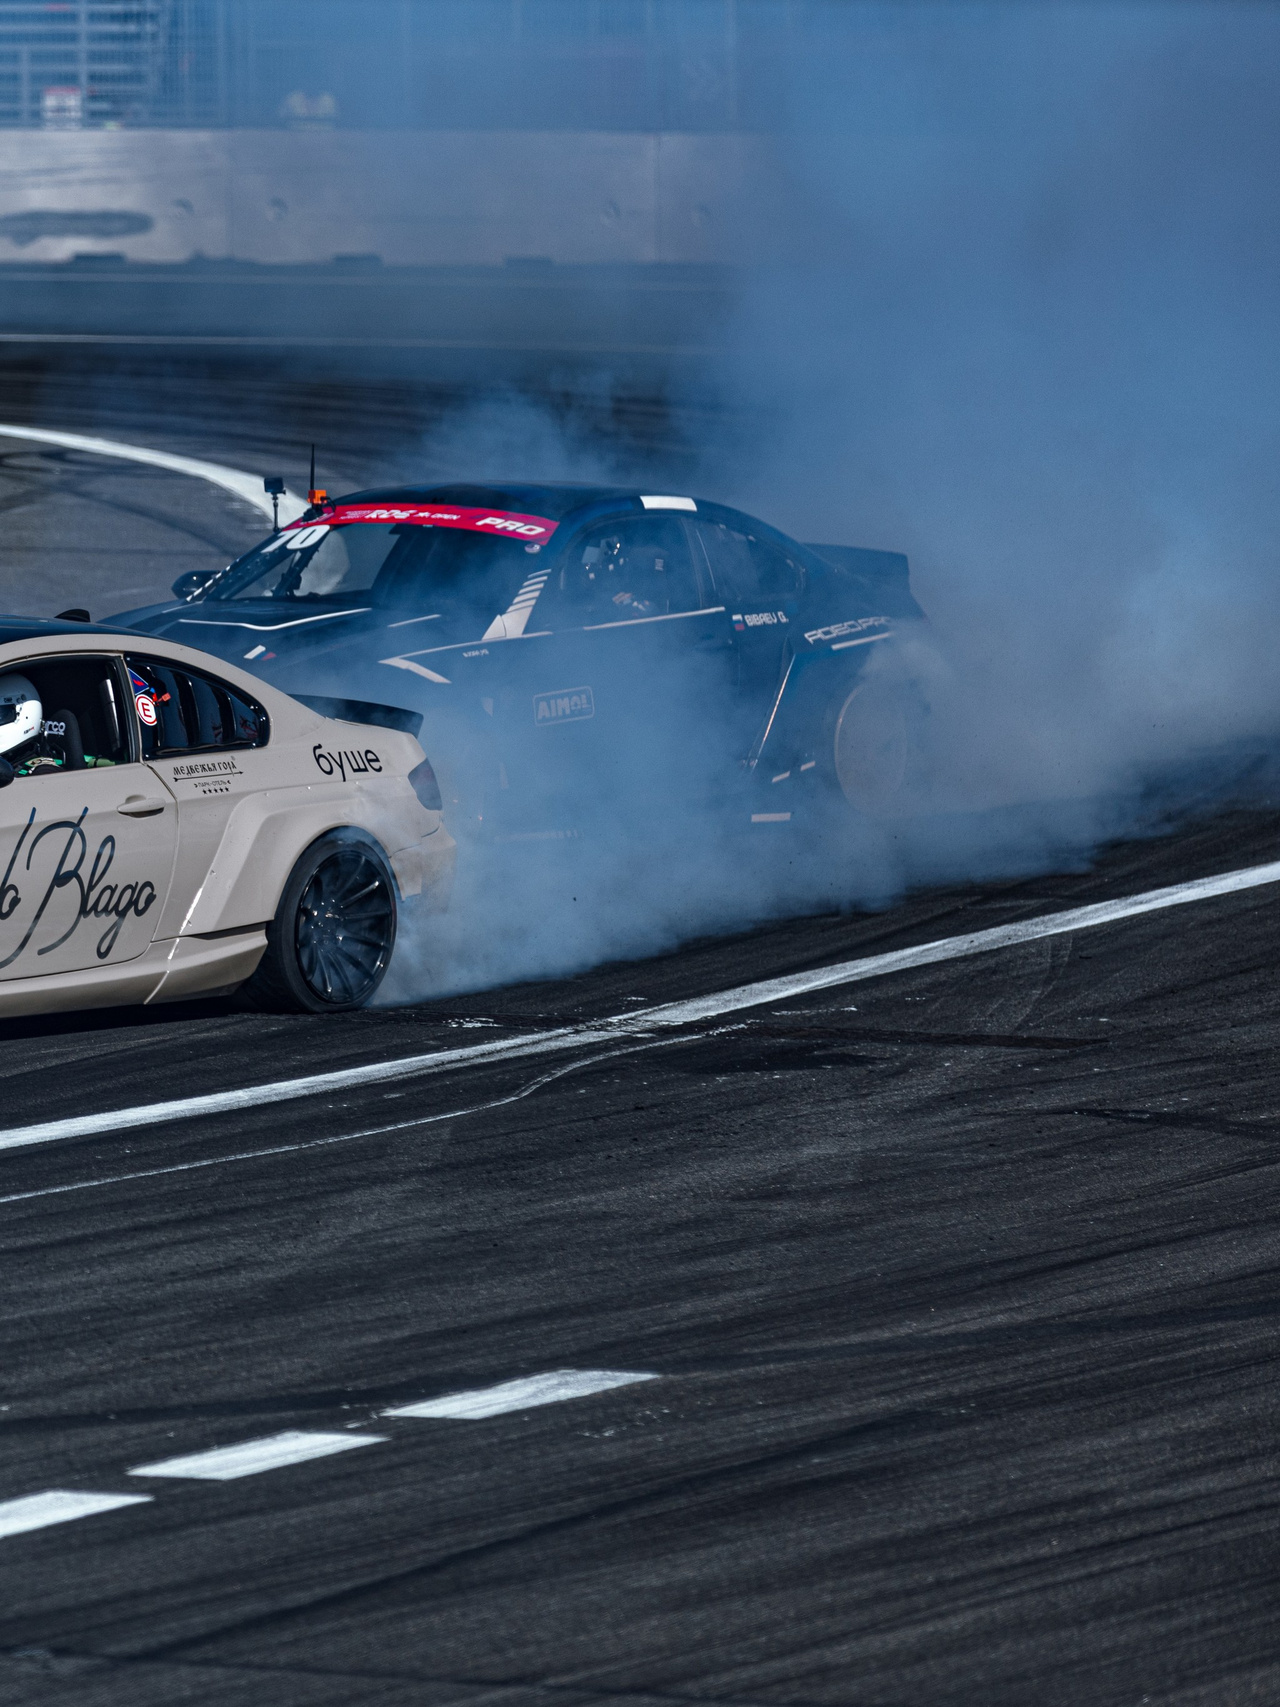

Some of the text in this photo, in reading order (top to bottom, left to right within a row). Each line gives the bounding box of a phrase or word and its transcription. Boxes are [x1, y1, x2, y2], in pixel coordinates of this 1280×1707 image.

[365, 509, 418, 519] RDS
[431, 512, 461, 520] OPEN
[476, 516, 546, 536] PRO
[260, 525, 331, 553] 10
[744, 610, 789, 627] BIBAEV G.
[141, 702, 152, 718] E
[538, 693, 591, 720] AIMOL
[313, 743, 383, 782] буше
